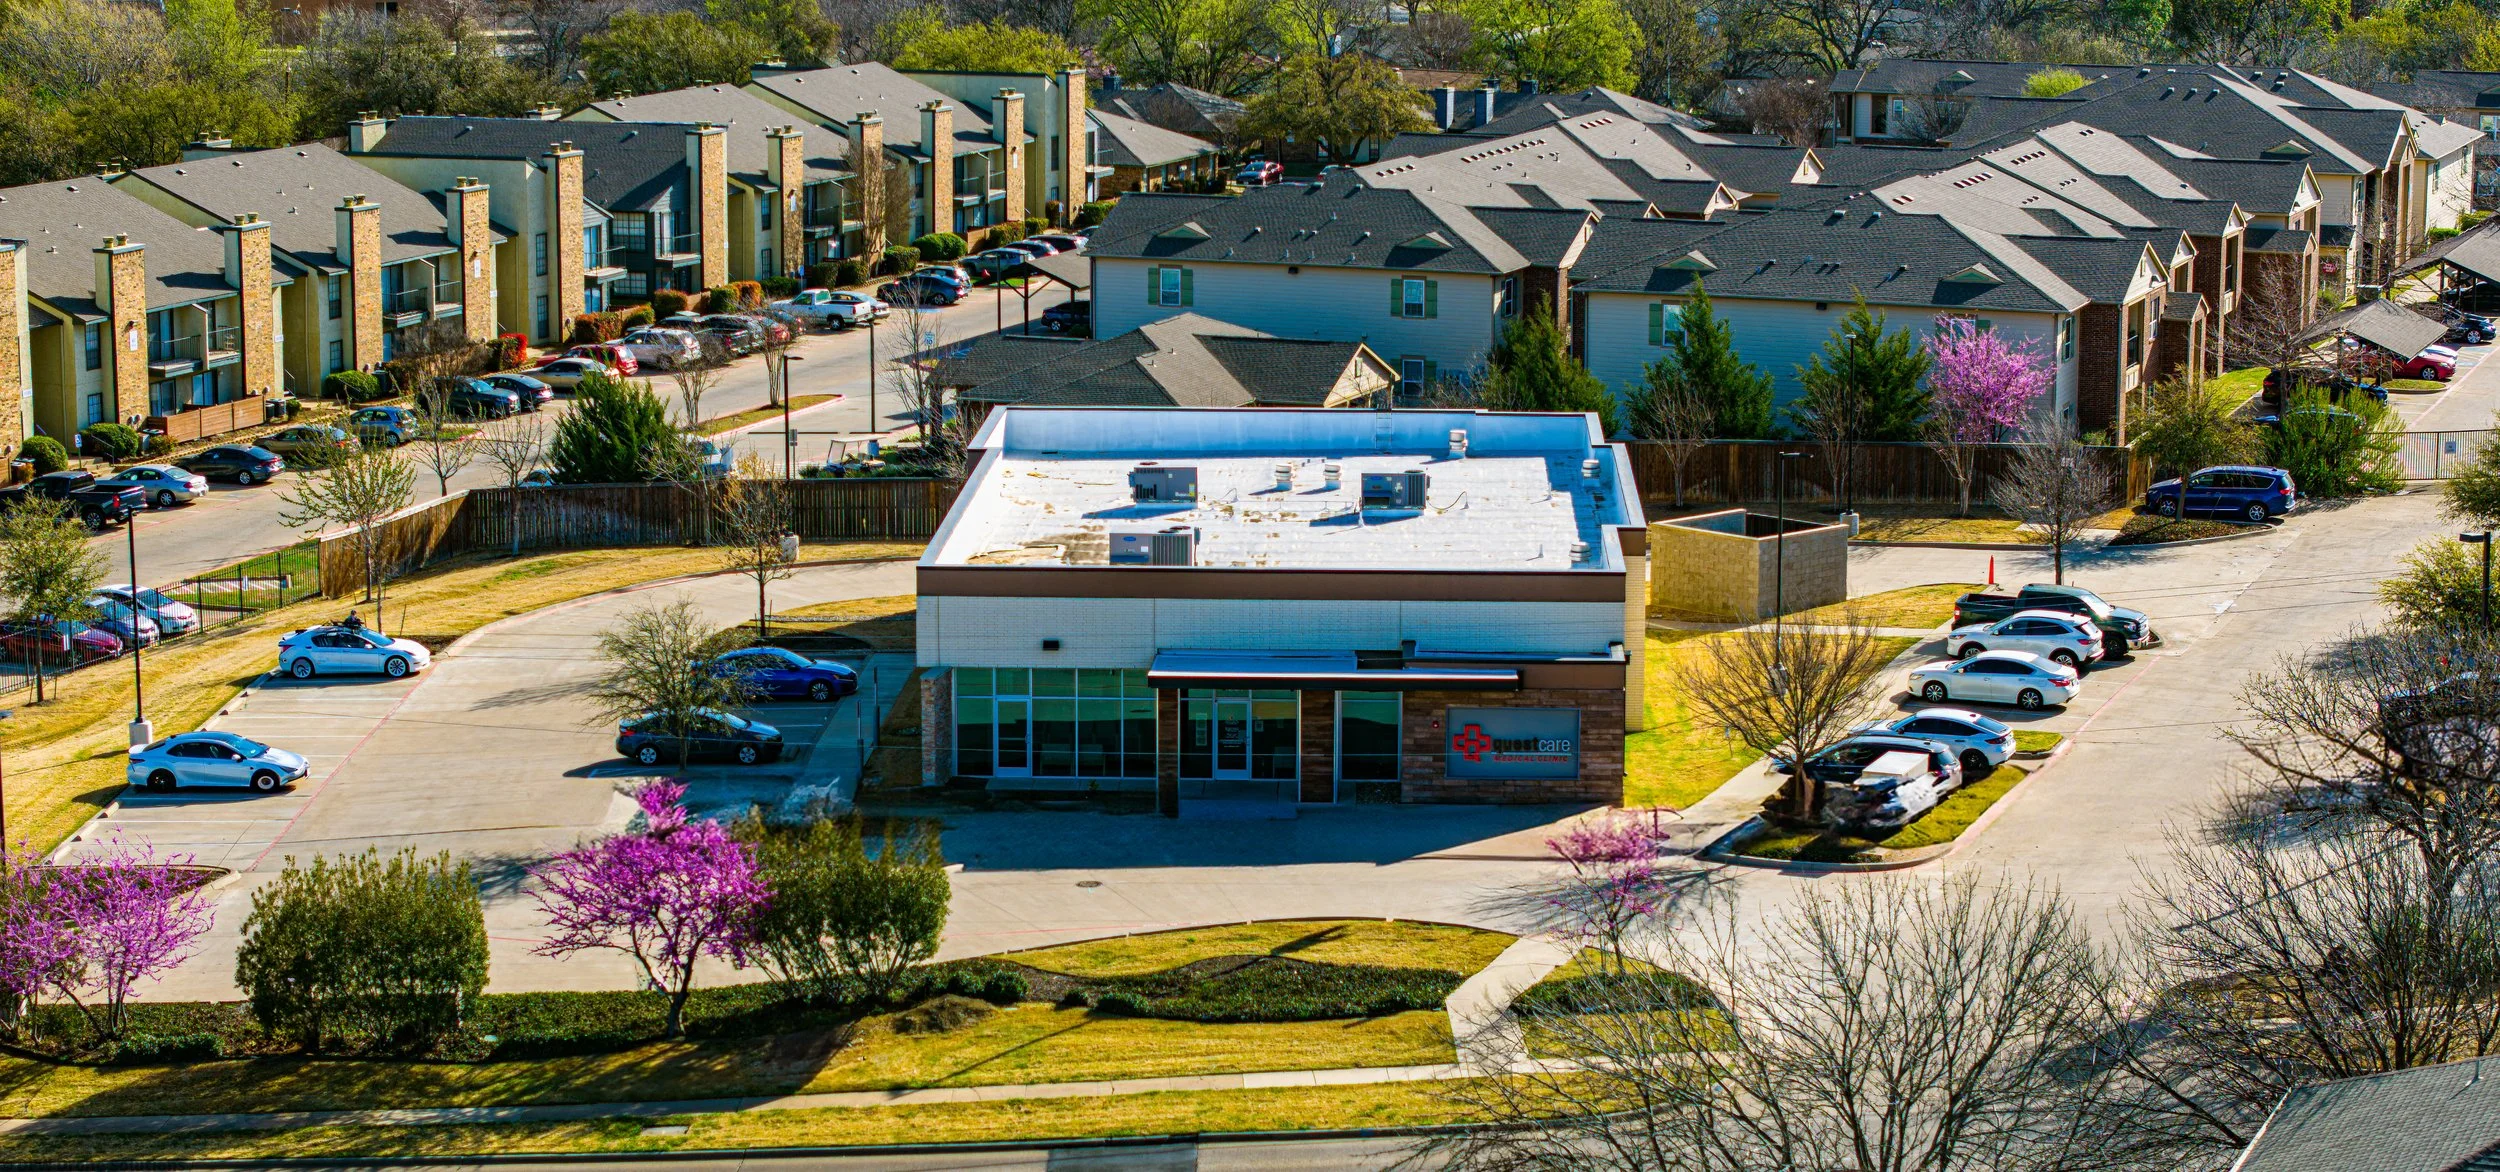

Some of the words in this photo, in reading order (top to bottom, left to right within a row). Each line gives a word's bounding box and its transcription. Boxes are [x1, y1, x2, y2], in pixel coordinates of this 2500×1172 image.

[1493, 736, 1570, 753] questcare
[1494, 755, 1534, 763] MEDICAL
[1536, 755, 1568, 763] CLINIC
